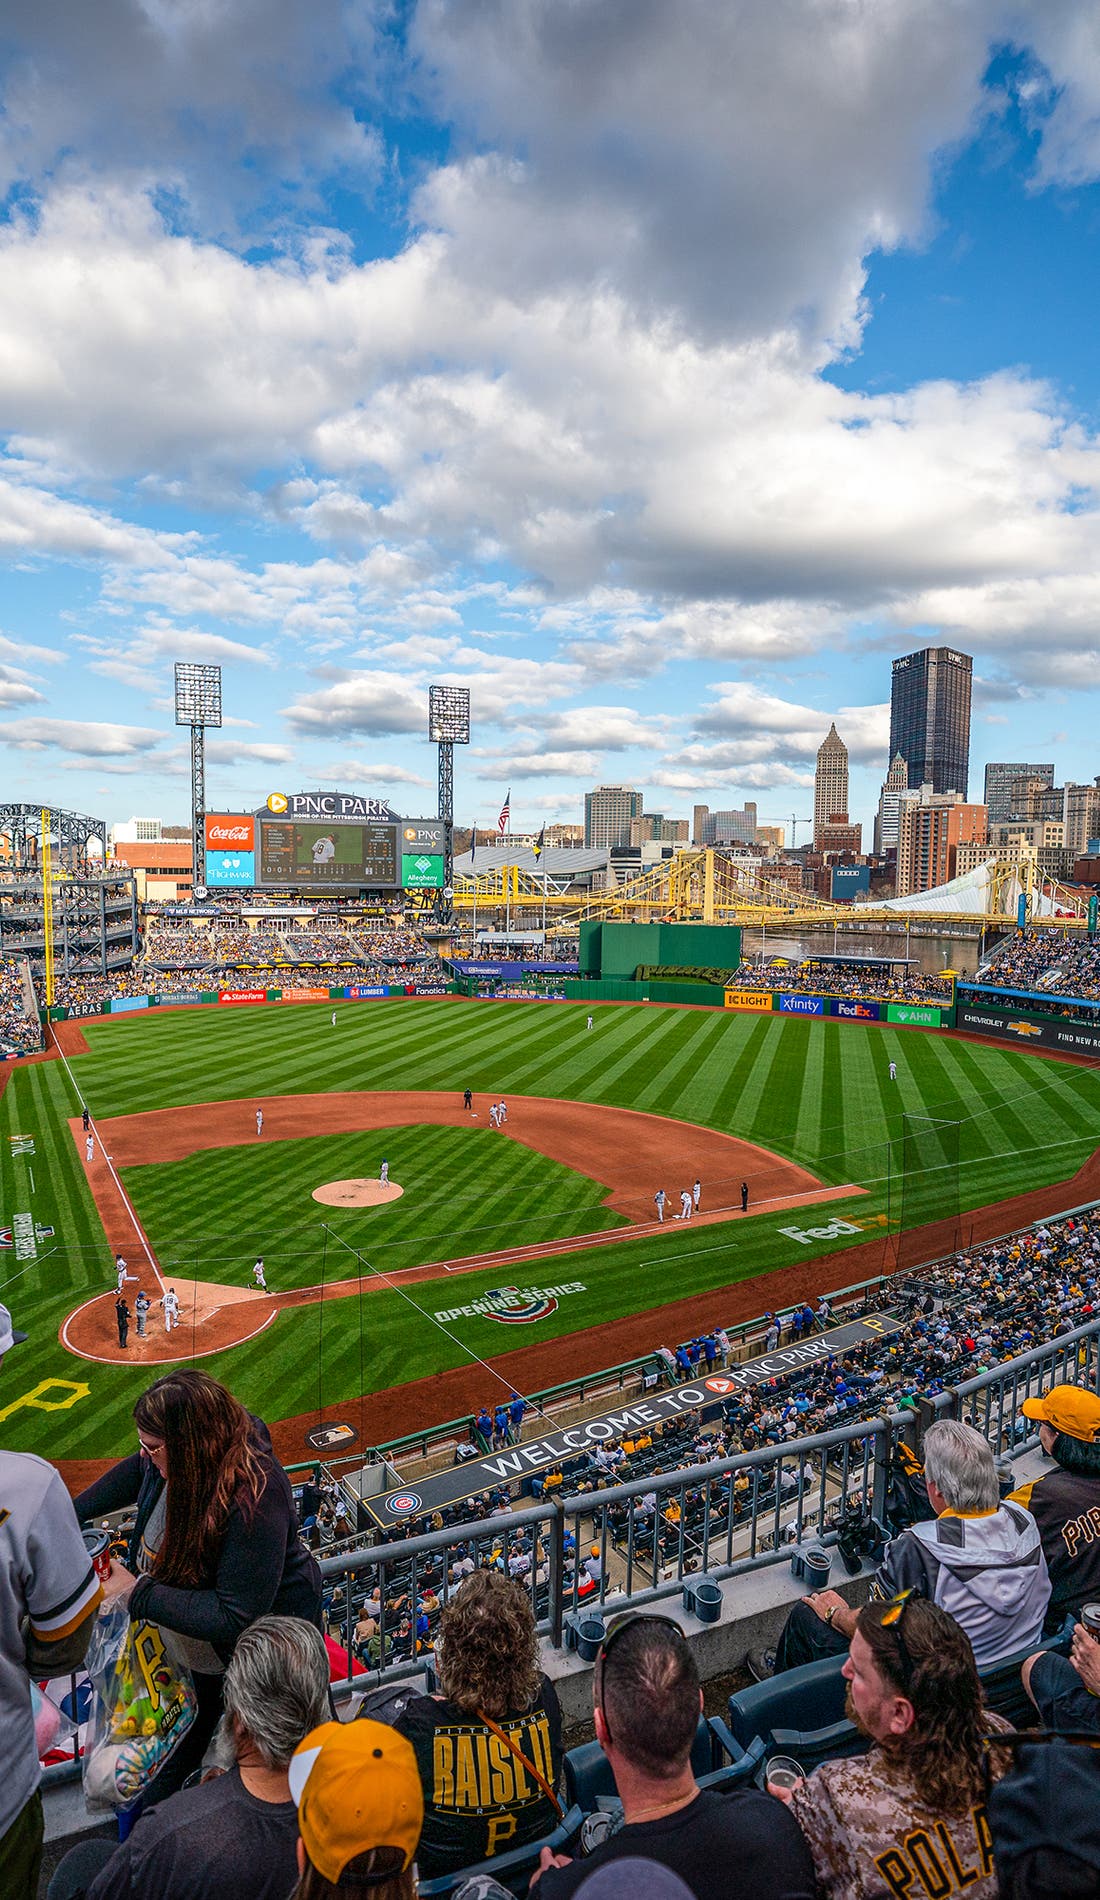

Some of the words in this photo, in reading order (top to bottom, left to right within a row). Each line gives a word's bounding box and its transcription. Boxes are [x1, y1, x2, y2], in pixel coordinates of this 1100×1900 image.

[291, 796, 336, 814] PNC
[340, 798, 390, 815] PARK
[418, 830, 441, 840] PNC
[408, 874, 438, 882] Allegheny
[360, 988, 384, 996] LUMBER
[728, 995, 738, 1004] IC
[741, 996, 768, 1006] LIGHT
[784, 998, 820, 1013] xfinity
[68, 1003, 102, 1016] AERAS
[910, 1012, 932, 1022] AHN
[964, 1014, 1004, 1028] CHEVROLET
[1058, 1032, 1074, 1042] FIND
[1076, 1036, 1092, 1046] NEW
[776, 1214, 901, 1245] FedEx
[433, 1296, 520, 1323] OPENING
[520, 1281, 588, 1303] SERIES
[862, 1318, 885, 1333] P
[480, 1404, 662, 1478] WELCOME
[656, 1389, 705, 1411] TO
[726, 1359, 786, 1384] PNC
[777, 1338, 840, 1365] PARK
[134, 1620, 167, 1713] P
[434, 1712, 546, 1735] PITTSURGH
[432, 1729, 531, 1807] RAISE
[528, 1718, 556, 1792] IT
[485, 1813, 518, 1857] P
